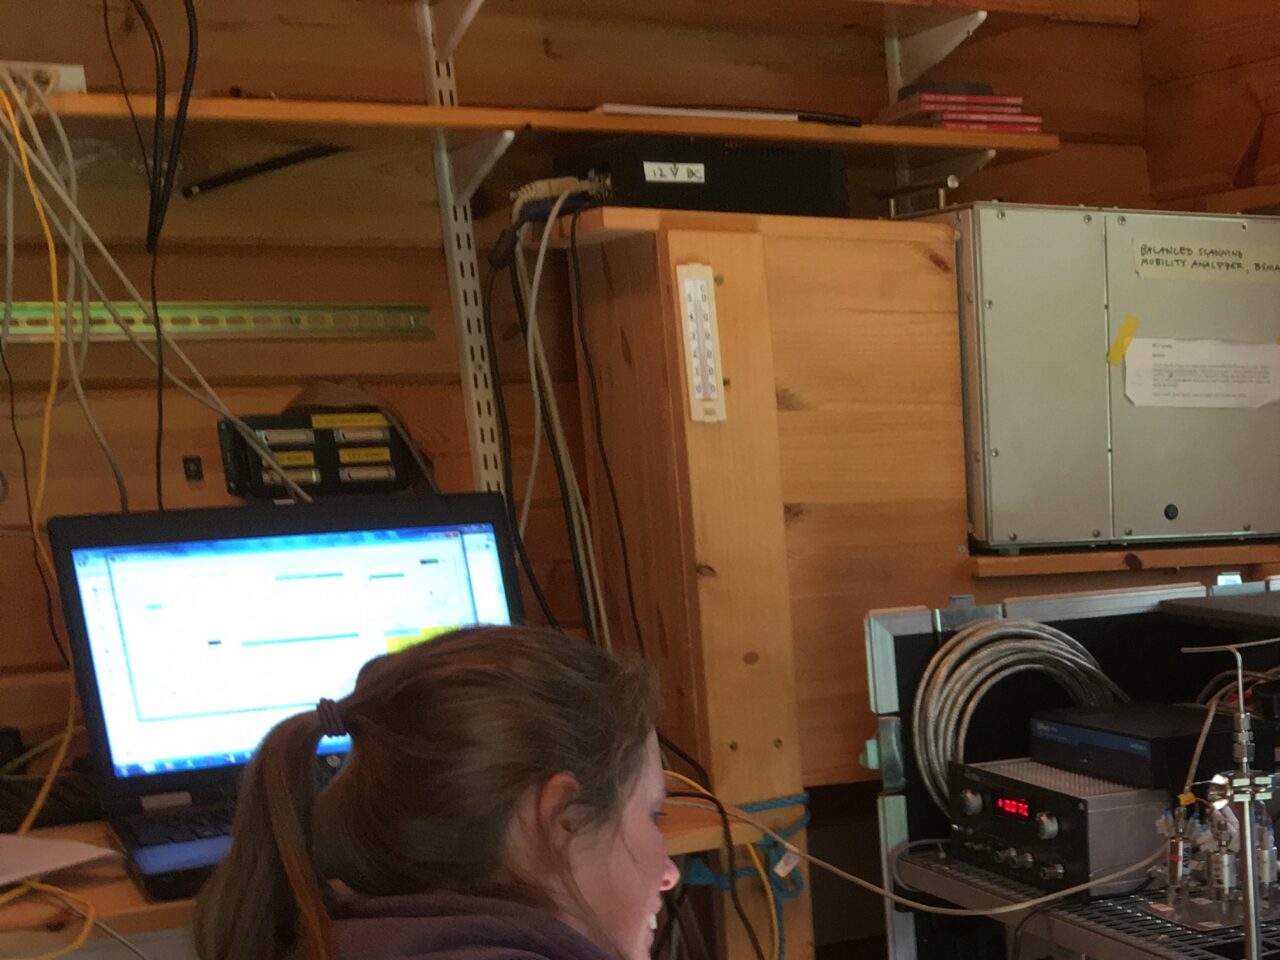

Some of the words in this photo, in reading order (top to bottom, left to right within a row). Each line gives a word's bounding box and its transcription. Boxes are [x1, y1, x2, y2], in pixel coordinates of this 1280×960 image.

[1140, 244, 1193, 257] BALANCED
[1198, 247, 1244, 259] SCANNING
[1140, 258, 1187, 268] MOBILITY
